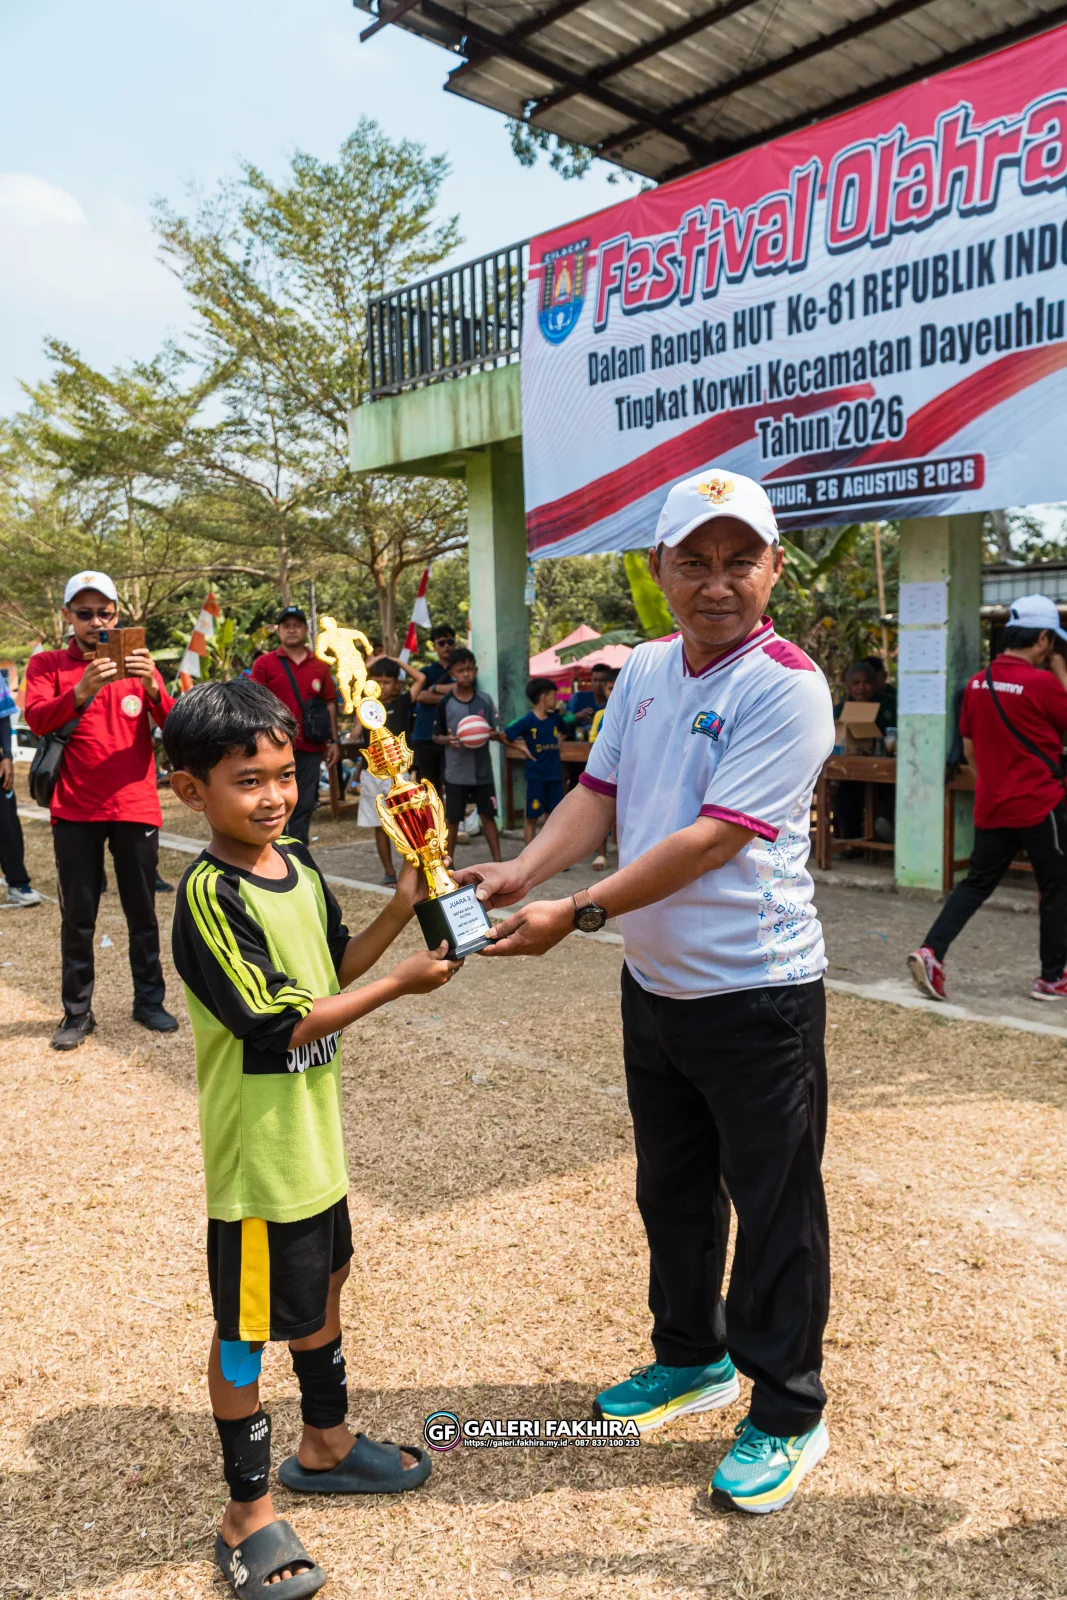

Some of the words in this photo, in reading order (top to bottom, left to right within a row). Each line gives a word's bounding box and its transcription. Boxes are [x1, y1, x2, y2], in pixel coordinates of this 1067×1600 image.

[594, 157, 821, 333] Festival
[826, 88, 1067, 255] Olahra
[543, 238, 588, 263] CILACAP
[588, 344, 645, 386] Dalam
[651, 320, 727, 370] Rangka
[733, 301, 776, 349] HUT
[787, 278, 855, 336] Ke-81
[863, 238, 997, 316] REPUBLIK
[615, 385, 688, 431] Tingkat
[693, 364, 762, 416] Korwil
[768, 335, 912, 400] Kecamatan
[920, 296, 1065, 368] Dayeuhlu
[758, 415, 830, 459] Tahun
[837, 395, 904, 446] 2026
[816, 479, 839, 502] 26
[842, 468, 919, 498] AGUSTUS
[924, 459, 975, 487] 2026
[450, 898, 466, 908] JUARA
